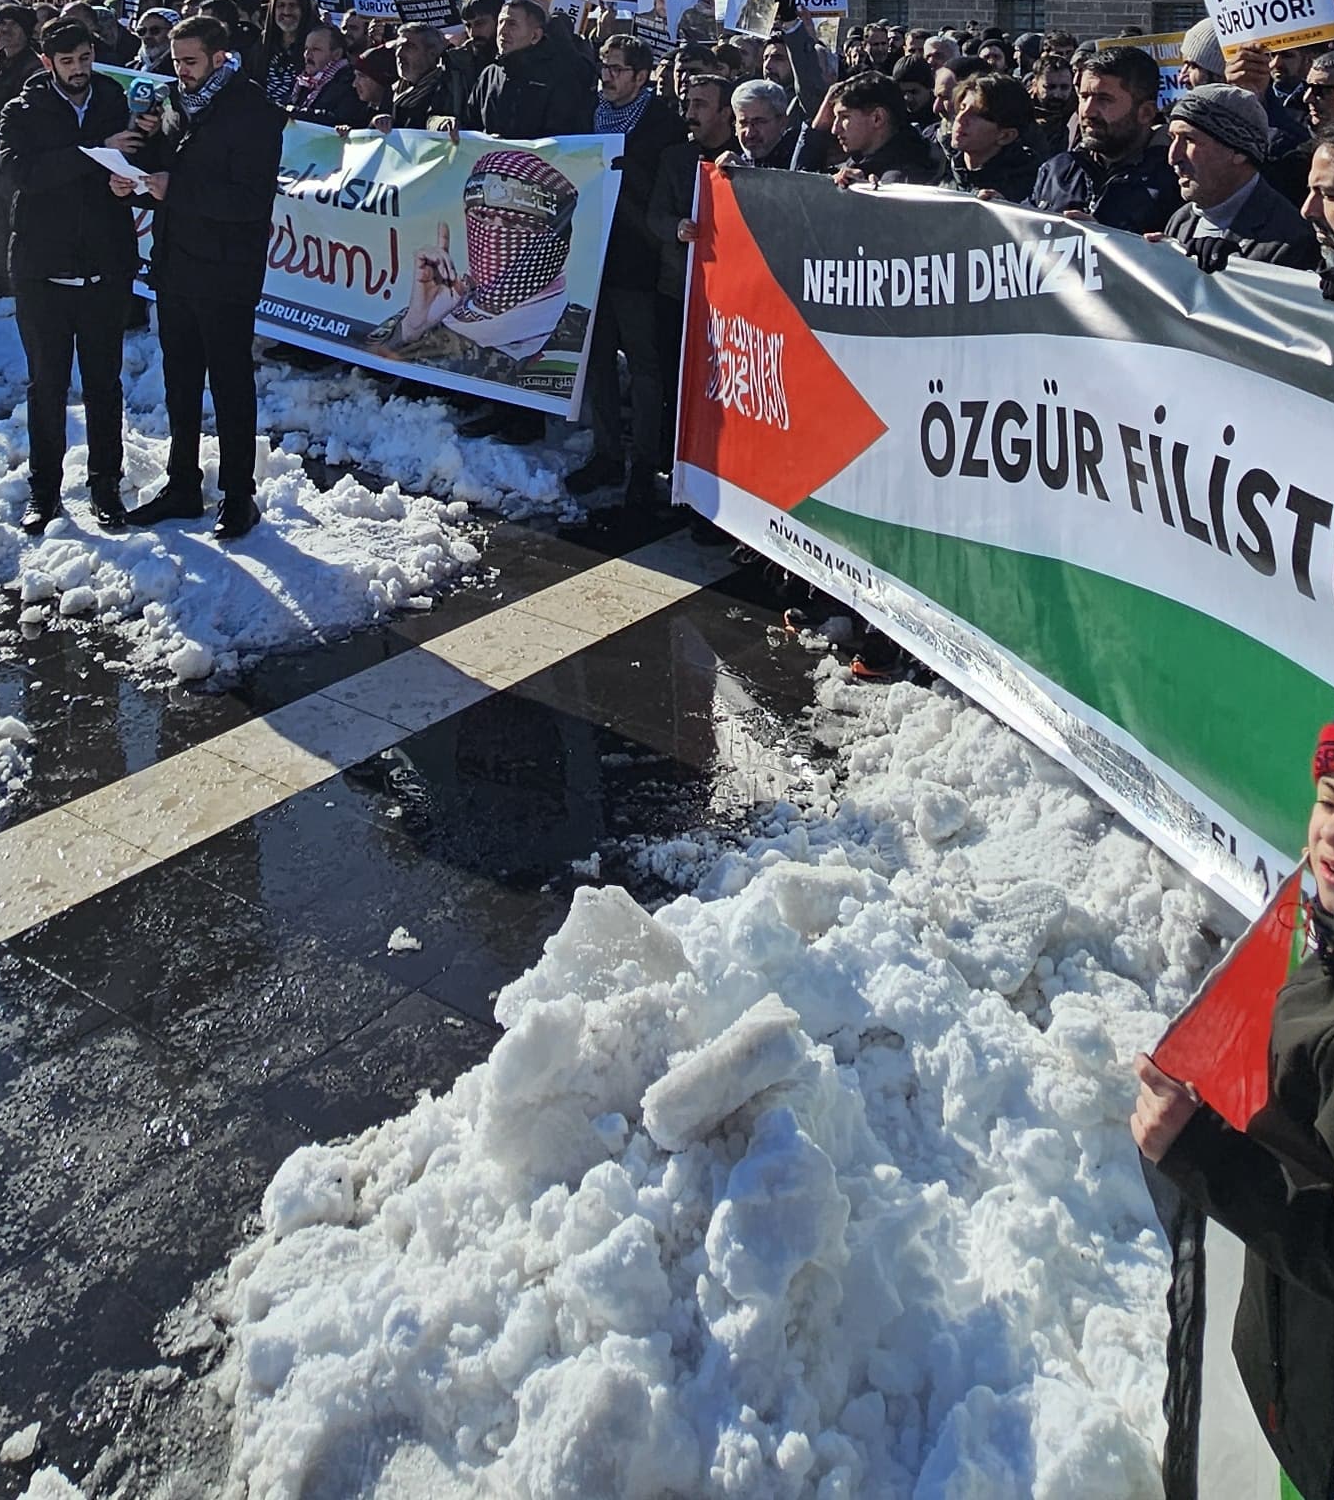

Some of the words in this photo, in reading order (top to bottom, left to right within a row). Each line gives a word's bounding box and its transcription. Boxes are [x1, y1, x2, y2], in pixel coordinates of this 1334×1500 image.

[803, 244, 956, 309] NEHİR'DEN
[968, 222, 1103, 296] DENİZ'E
[920, 379, 1106, 502] ÖZGÜR
